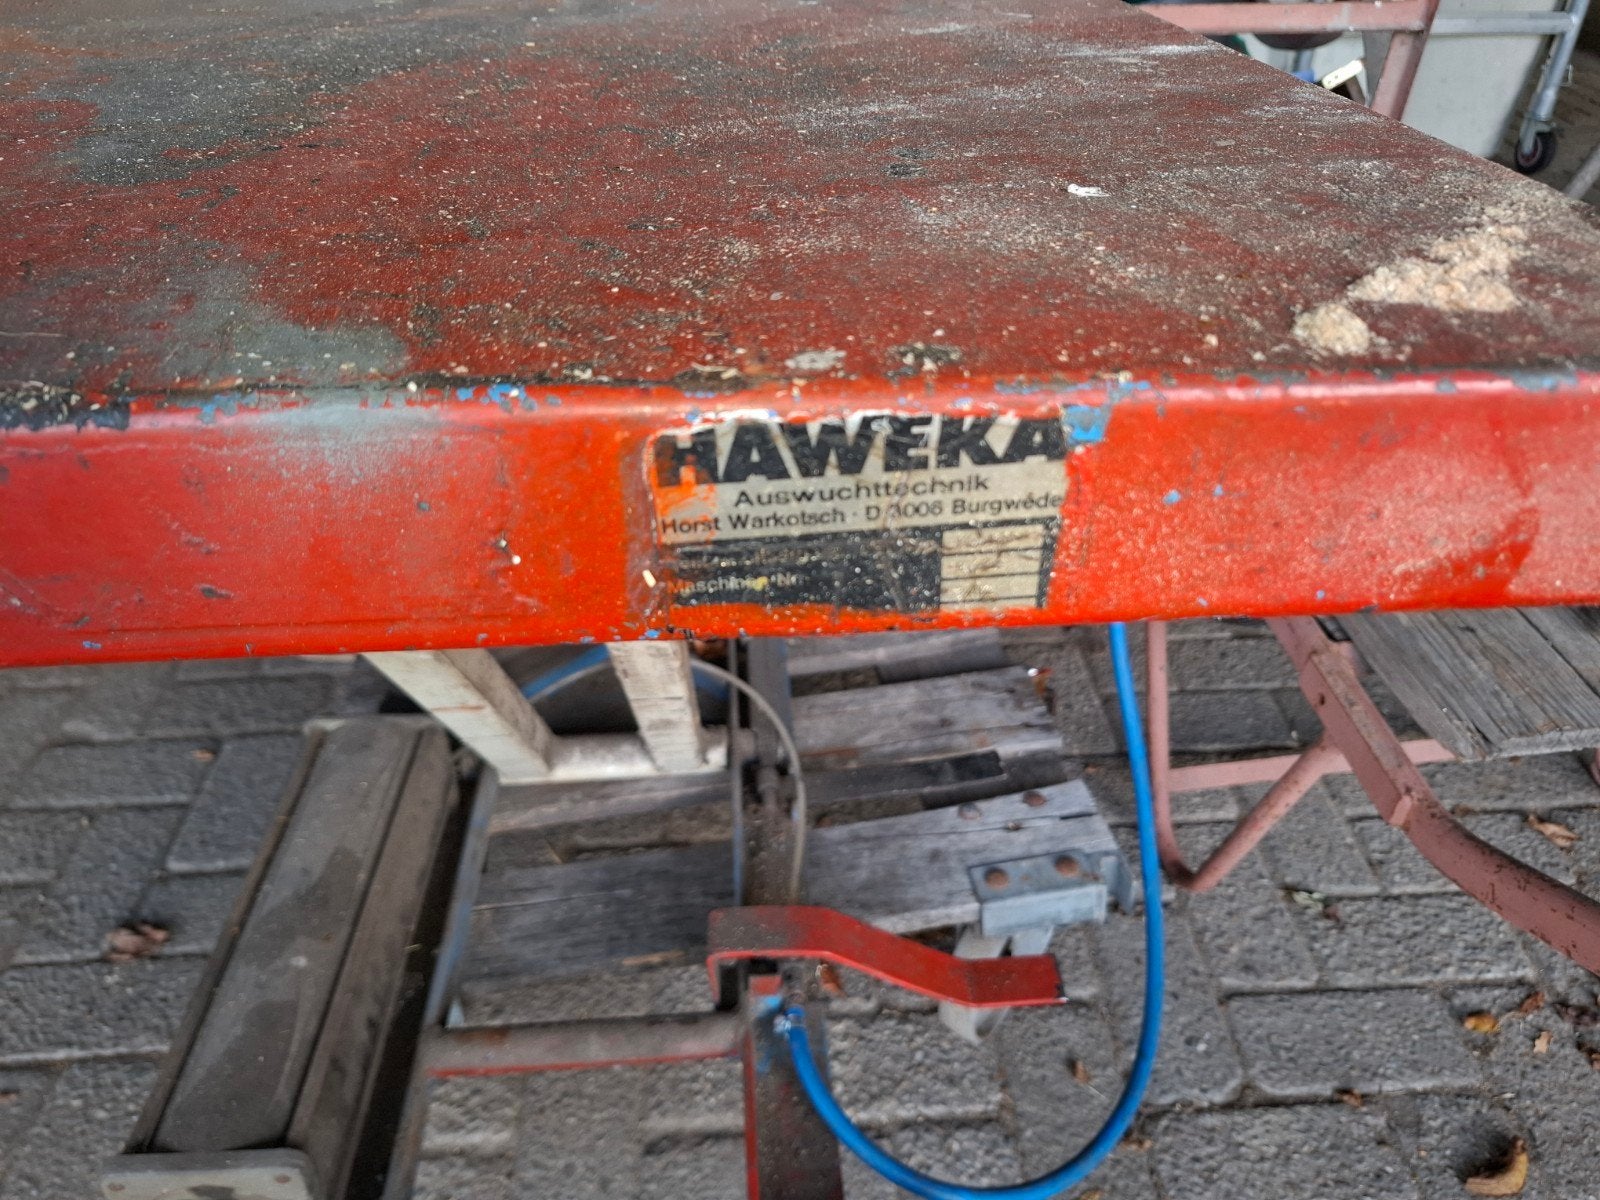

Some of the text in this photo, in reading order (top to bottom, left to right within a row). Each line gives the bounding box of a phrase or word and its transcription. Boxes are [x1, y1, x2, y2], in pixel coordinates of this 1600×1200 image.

[656, 416, 1068, 488] HAWEKA
[734, 475, 989, 507] Auswuchttechnik
[662, 515, 721, 534] Horst
[728, 508, 846, 531] Warkotsch
[865, 504, 881, 521] D
